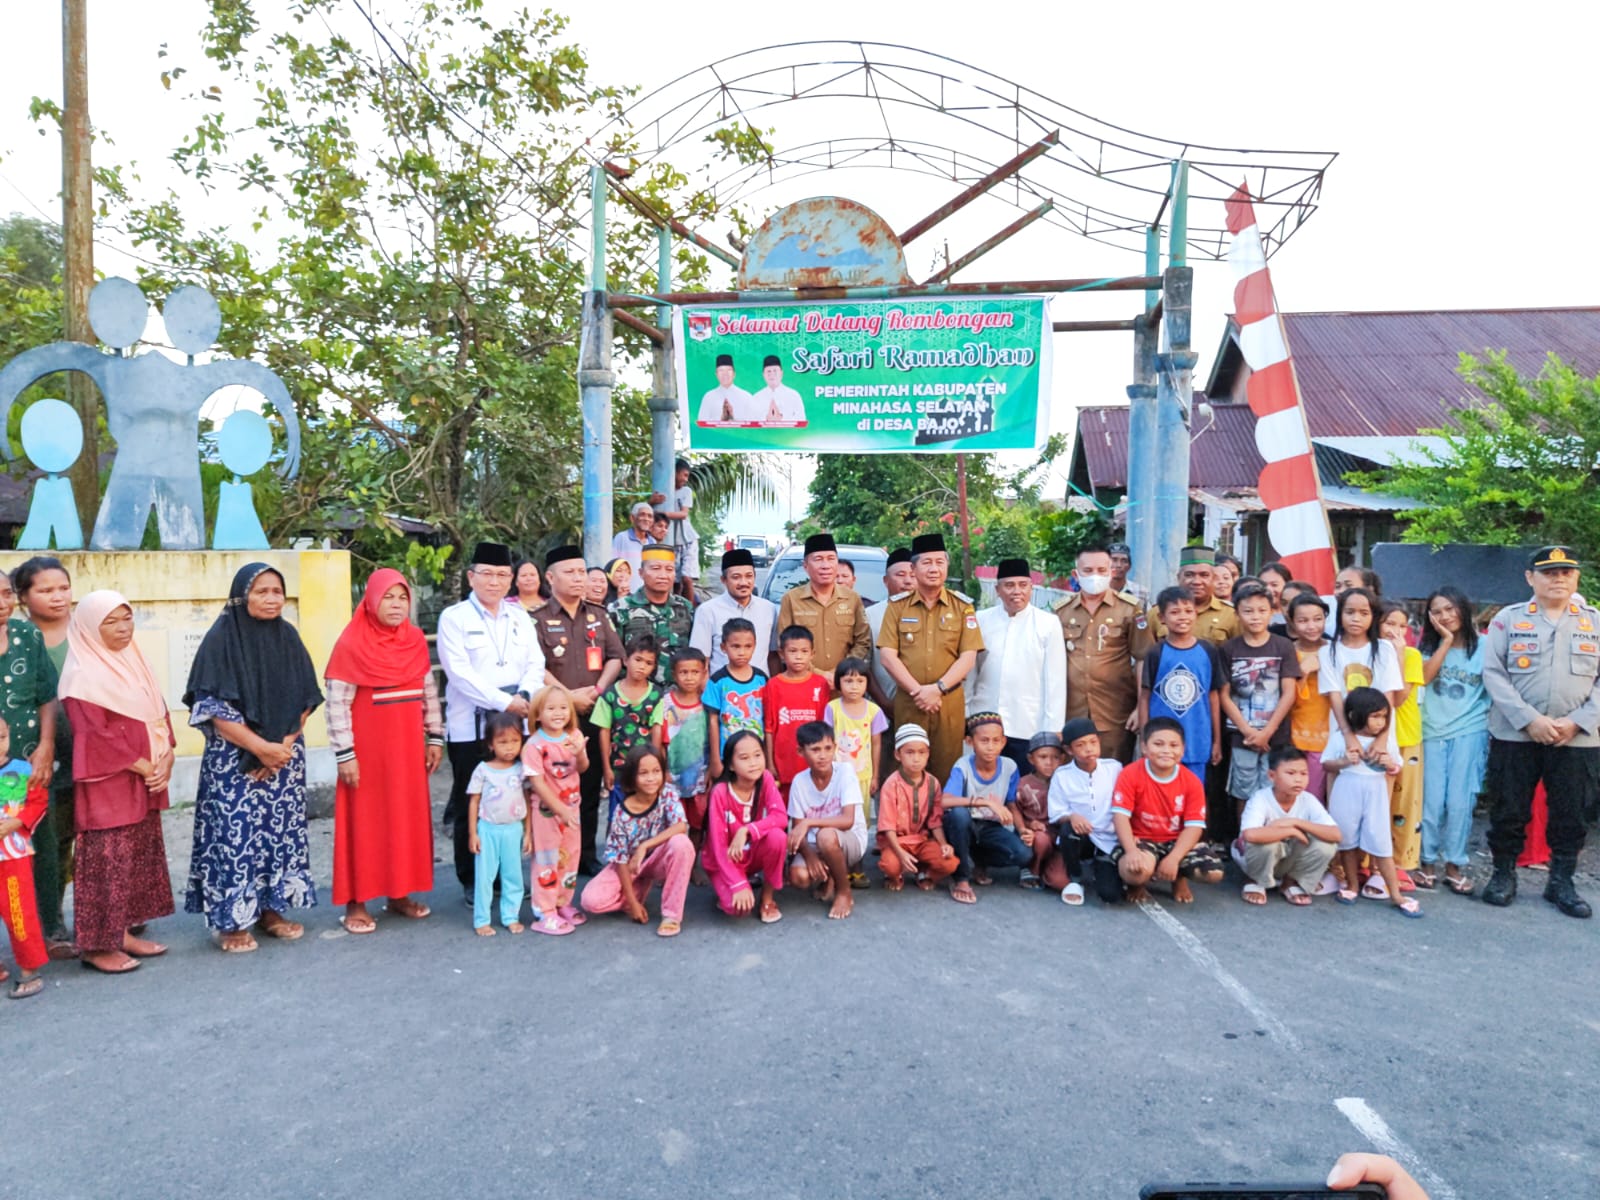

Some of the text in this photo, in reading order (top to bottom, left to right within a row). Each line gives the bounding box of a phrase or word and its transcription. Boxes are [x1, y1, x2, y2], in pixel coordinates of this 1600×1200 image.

[716, 309, 1014, 336] Selamat Datang Rombongan
[792, 342, 1035, 375] Safari Ramadhan
[814, 382, 1007, 398] PEMERINTAH KABUPATEN
[832, 400, 987, 415] MINAHASA SELATAN
[856, 417, 959, 431] di DESA BAJO
[1572, 633, 1599, 641] POLRI
